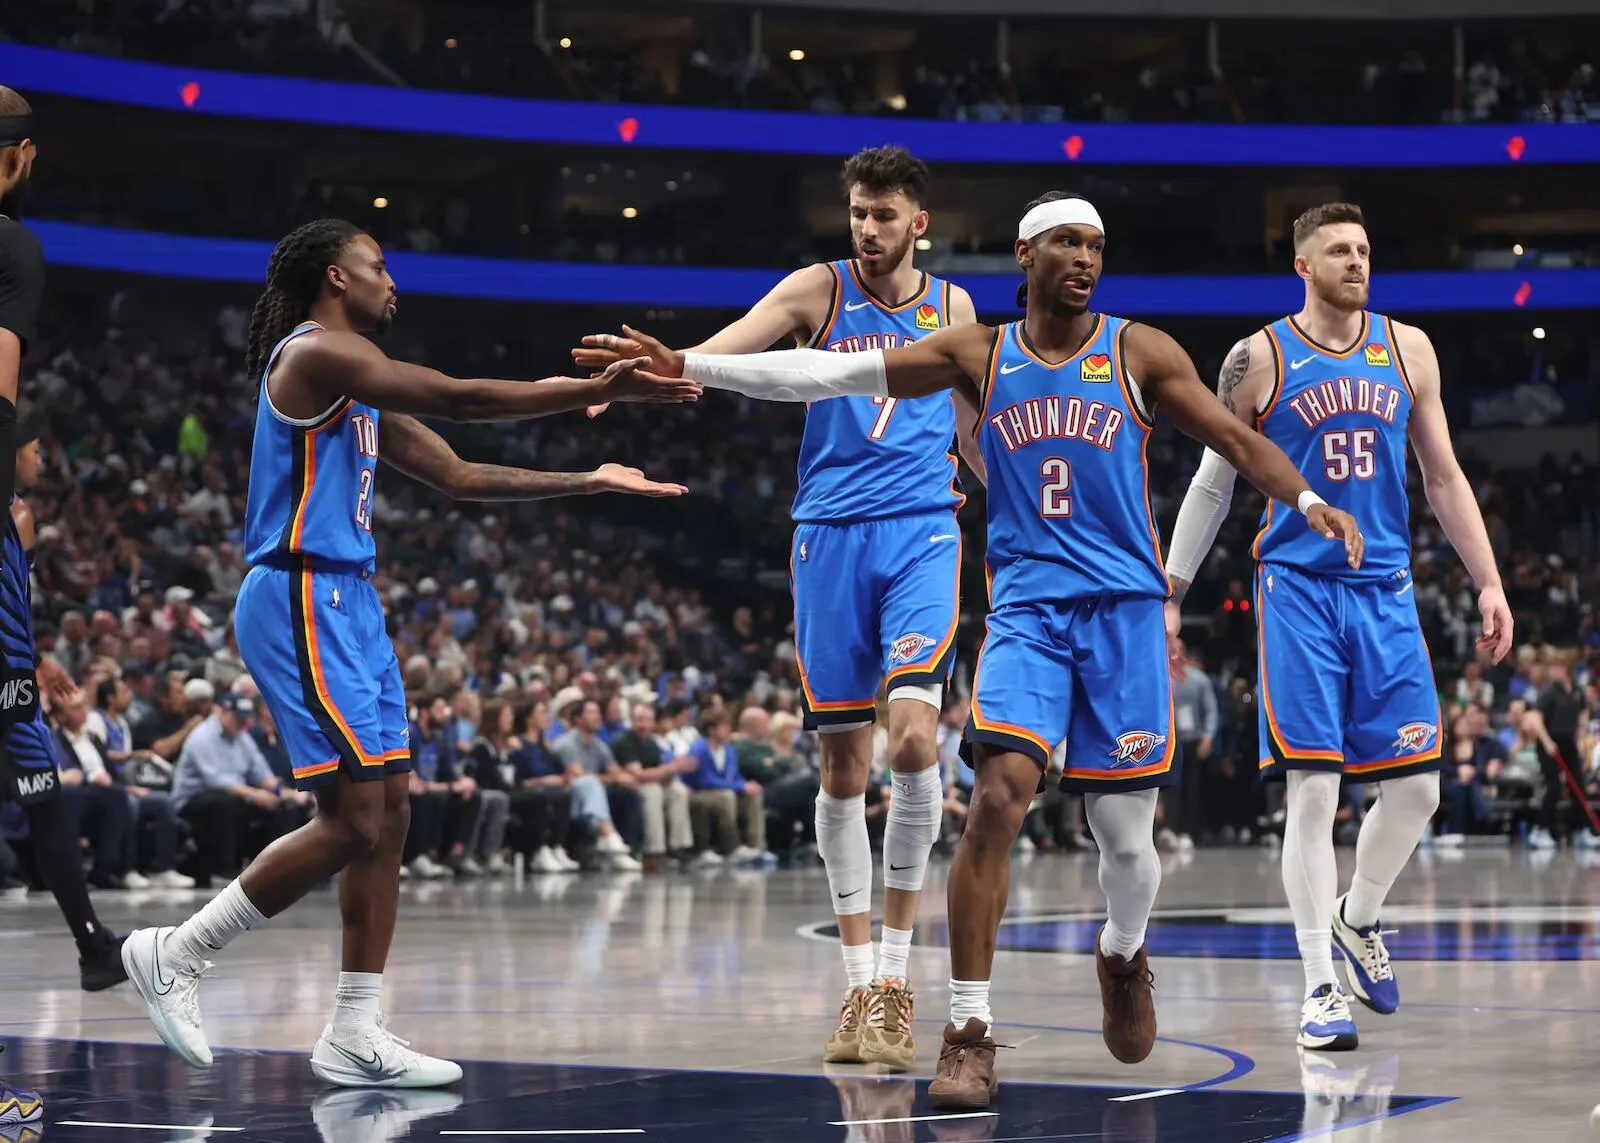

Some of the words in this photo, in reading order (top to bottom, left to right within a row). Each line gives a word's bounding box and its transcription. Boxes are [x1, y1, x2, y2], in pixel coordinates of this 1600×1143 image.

[1083, 371, 1110, 380] Love's
[868, 394, 898, 441] 7
[990, 396, 1124, 453] THUNDER
[1288, 376, 1402, 430] THUNDER
[1323, 427, 1377, 482] 55
[1040, 456, 1072, 519] 2
[1119, 737, 1148, 760] OKC
[17, 771, 55, 796] MAVS
